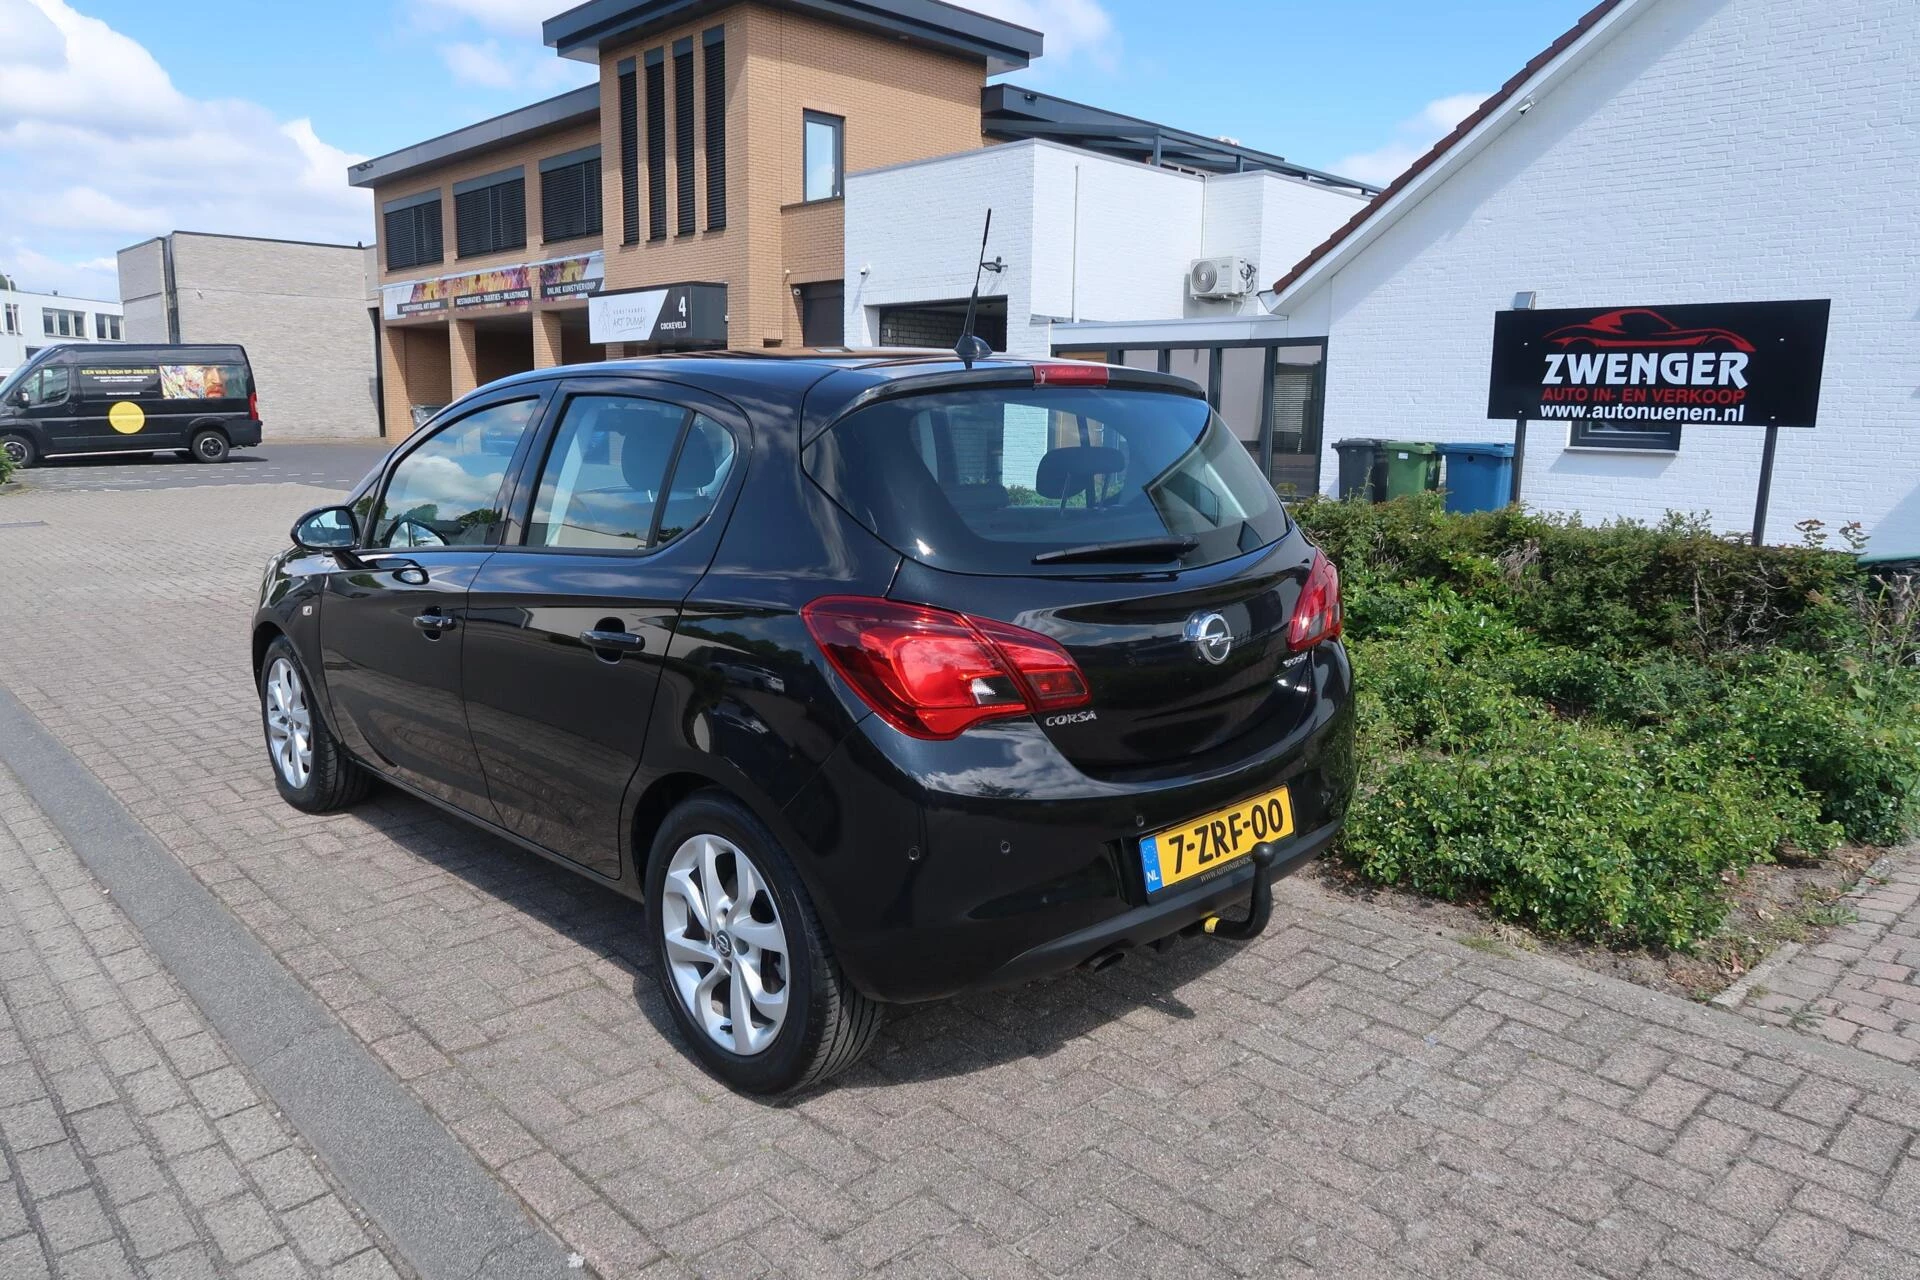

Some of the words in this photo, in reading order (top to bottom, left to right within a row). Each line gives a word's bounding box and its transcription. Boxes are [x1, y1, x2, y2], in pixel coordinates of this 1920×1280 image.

[678, 296, 687, 317] 4
[660, 321, 687, 330] COCKEVELD
[1541, 352, 1749, 390] ZWENGER
[1542, 387, 1588, 401] AUTO
[1593, 388, 1616, 401] IN-
[1622, 388, 1646, 402] EN
[1651, 389, 1746, 405] VERKOOP
[1540, 403, 1745, 422] www.autonuenen.nl
[1045, 709, 1098, 727] CORSA
[1168, 798, 1284, 875] 7-ZRF-00
[1146, 869, 1160, 881] NL
